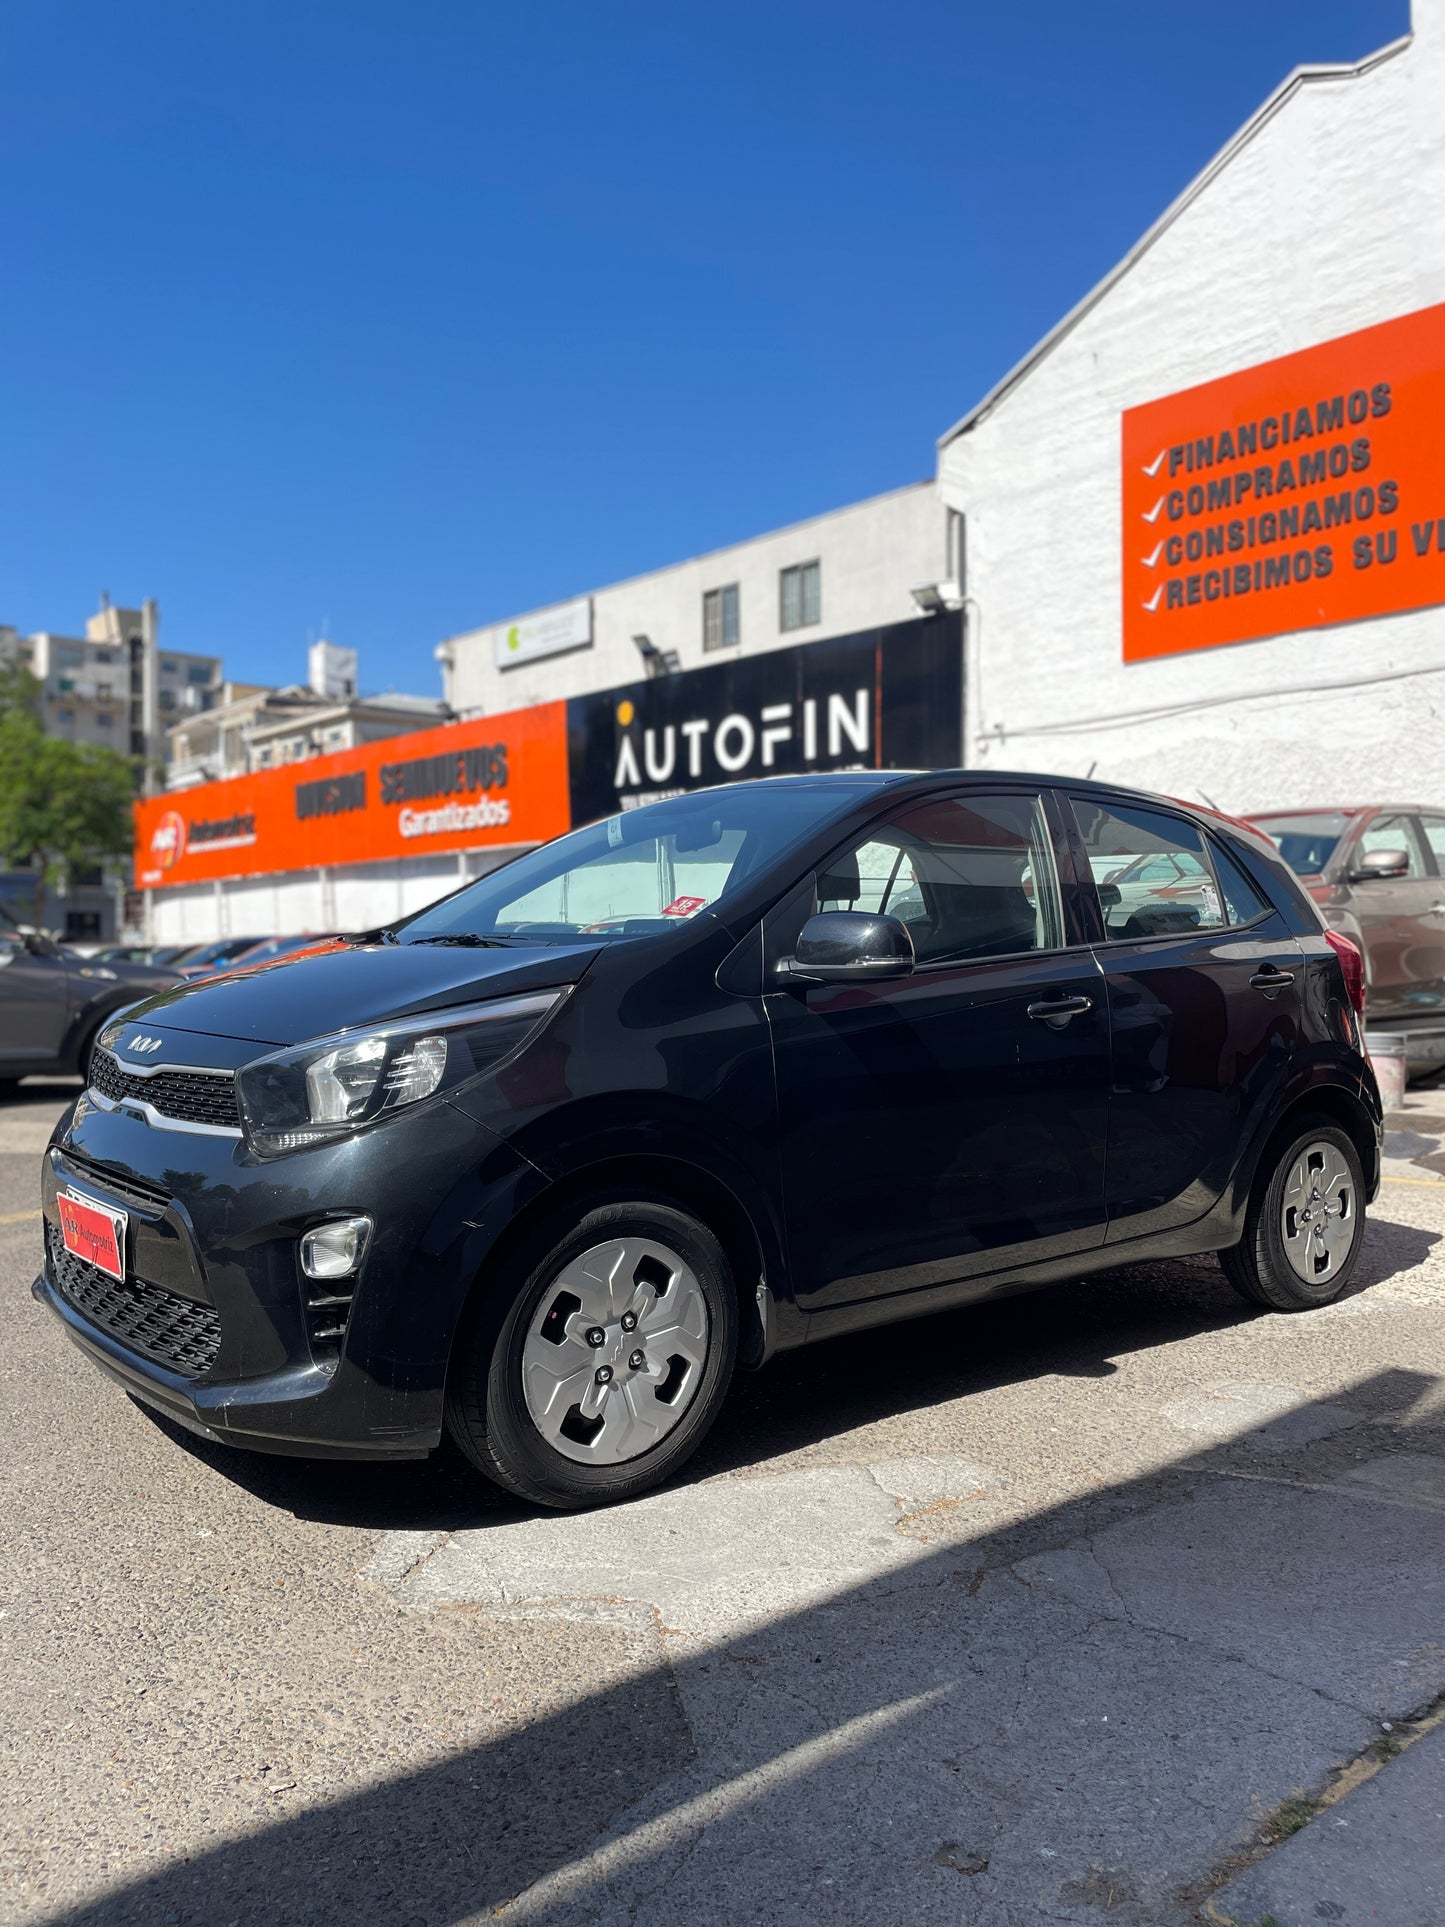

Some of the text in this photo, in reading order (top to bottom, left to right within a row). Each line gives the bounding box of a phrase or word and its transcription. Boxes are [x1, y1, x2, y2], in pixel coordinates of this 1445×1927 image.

[1168, 383, 1392, 477] FINANCIAMOS
[1167, 438, 1371, 521] COMPRAMOS
[1165, 481, 1399, 566] CONSIGNAMOS
[1166, 546, 1334, 610] RECIBIMOS
[1354, 530, 1397, 570] SU
[614, 689, 869, 788] AUTOFIN
[399, 796, 510, 838] Garantizados
